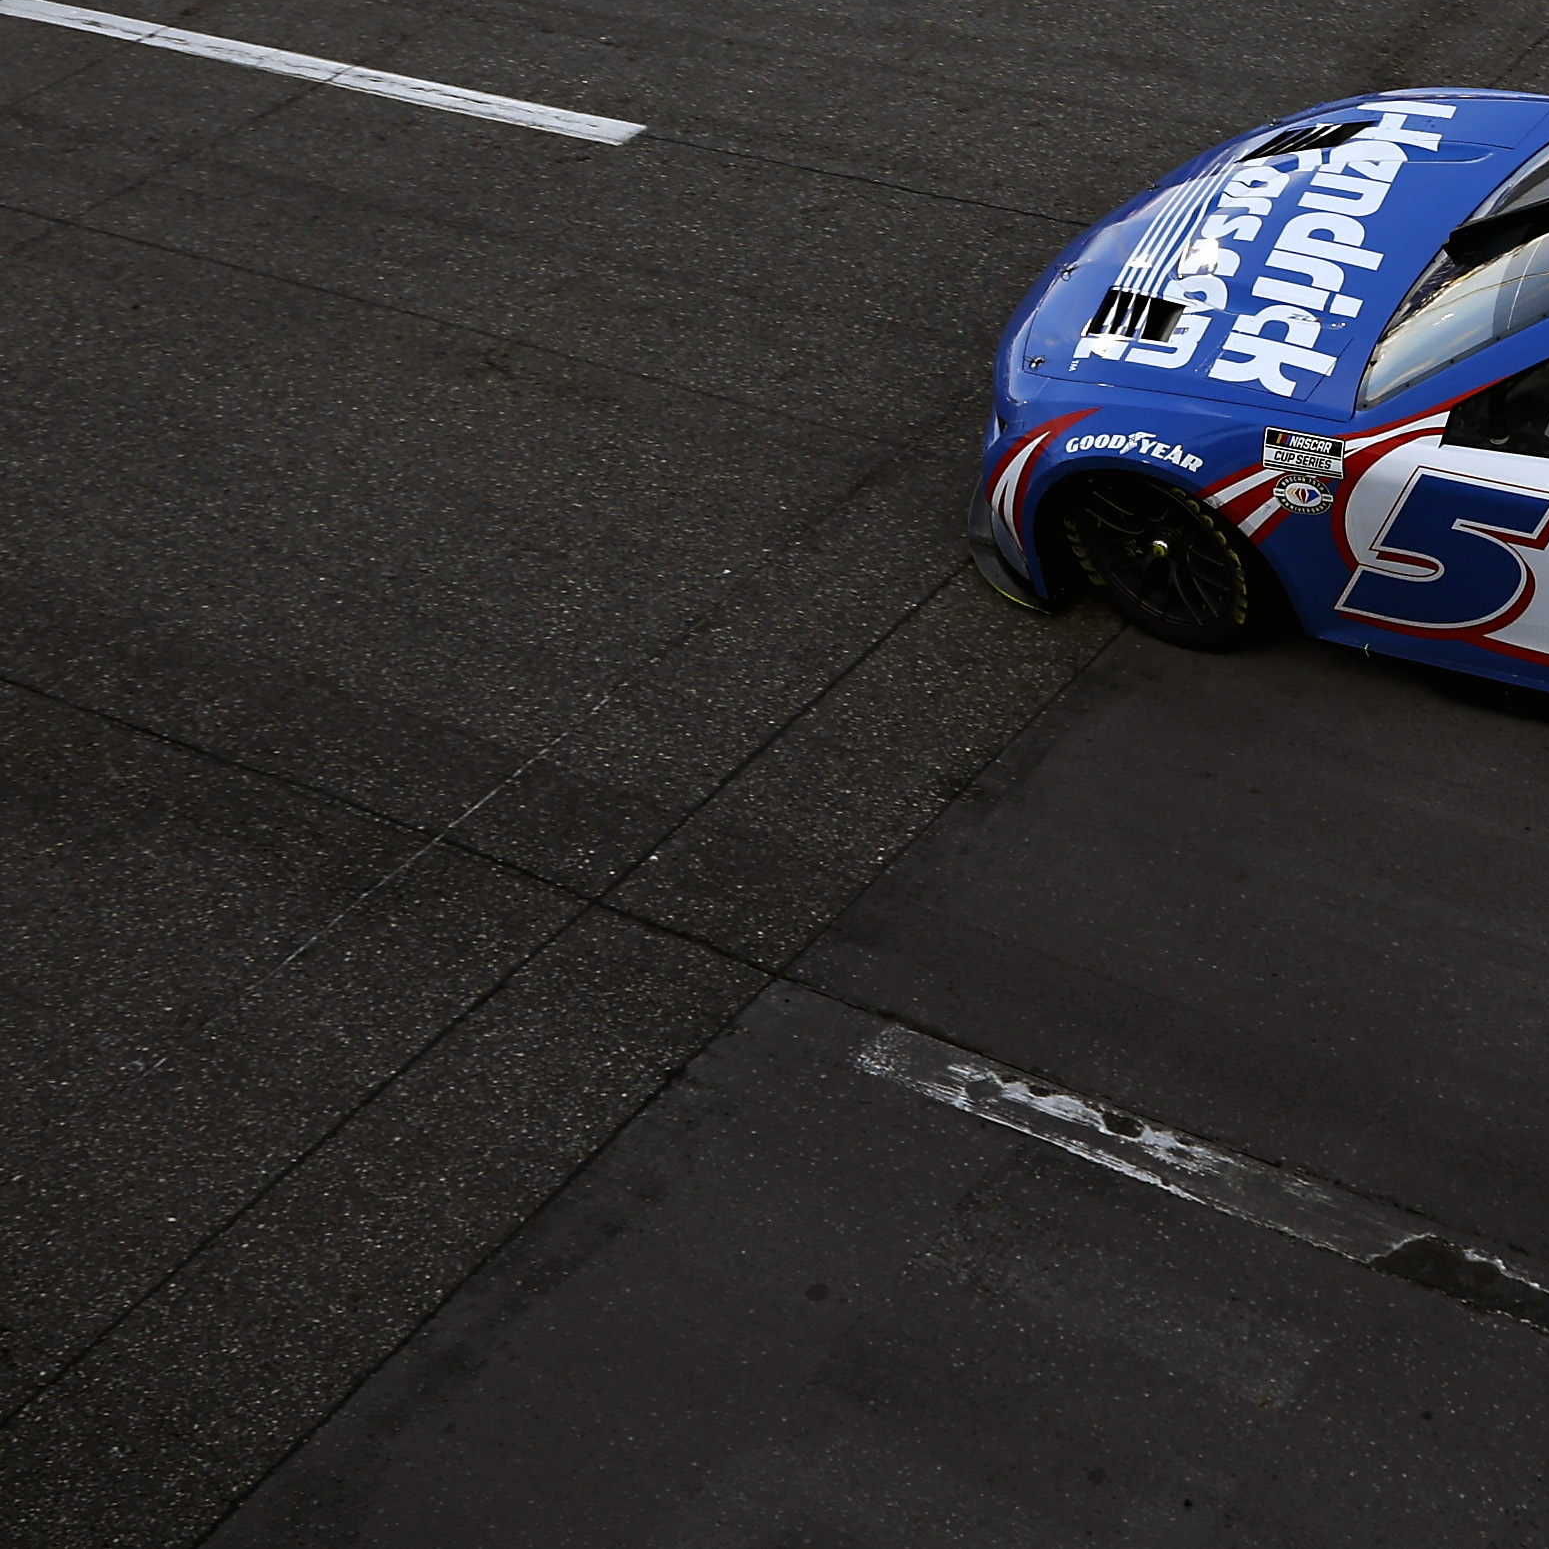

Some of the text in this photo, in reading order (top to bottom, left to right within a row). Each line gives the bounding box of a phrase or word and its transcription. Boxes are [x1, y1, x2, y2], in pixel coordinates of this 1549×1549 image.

[1124, 148, 1323, 370] Carscom
[1208, 100, 1457, 398] Hendrick
[1065, 431, 1204, 473] GOODYEAR
[1273, 450, 1332, 470] CUP SERIES
[1289, 435, 1333, 454] NASCAR
